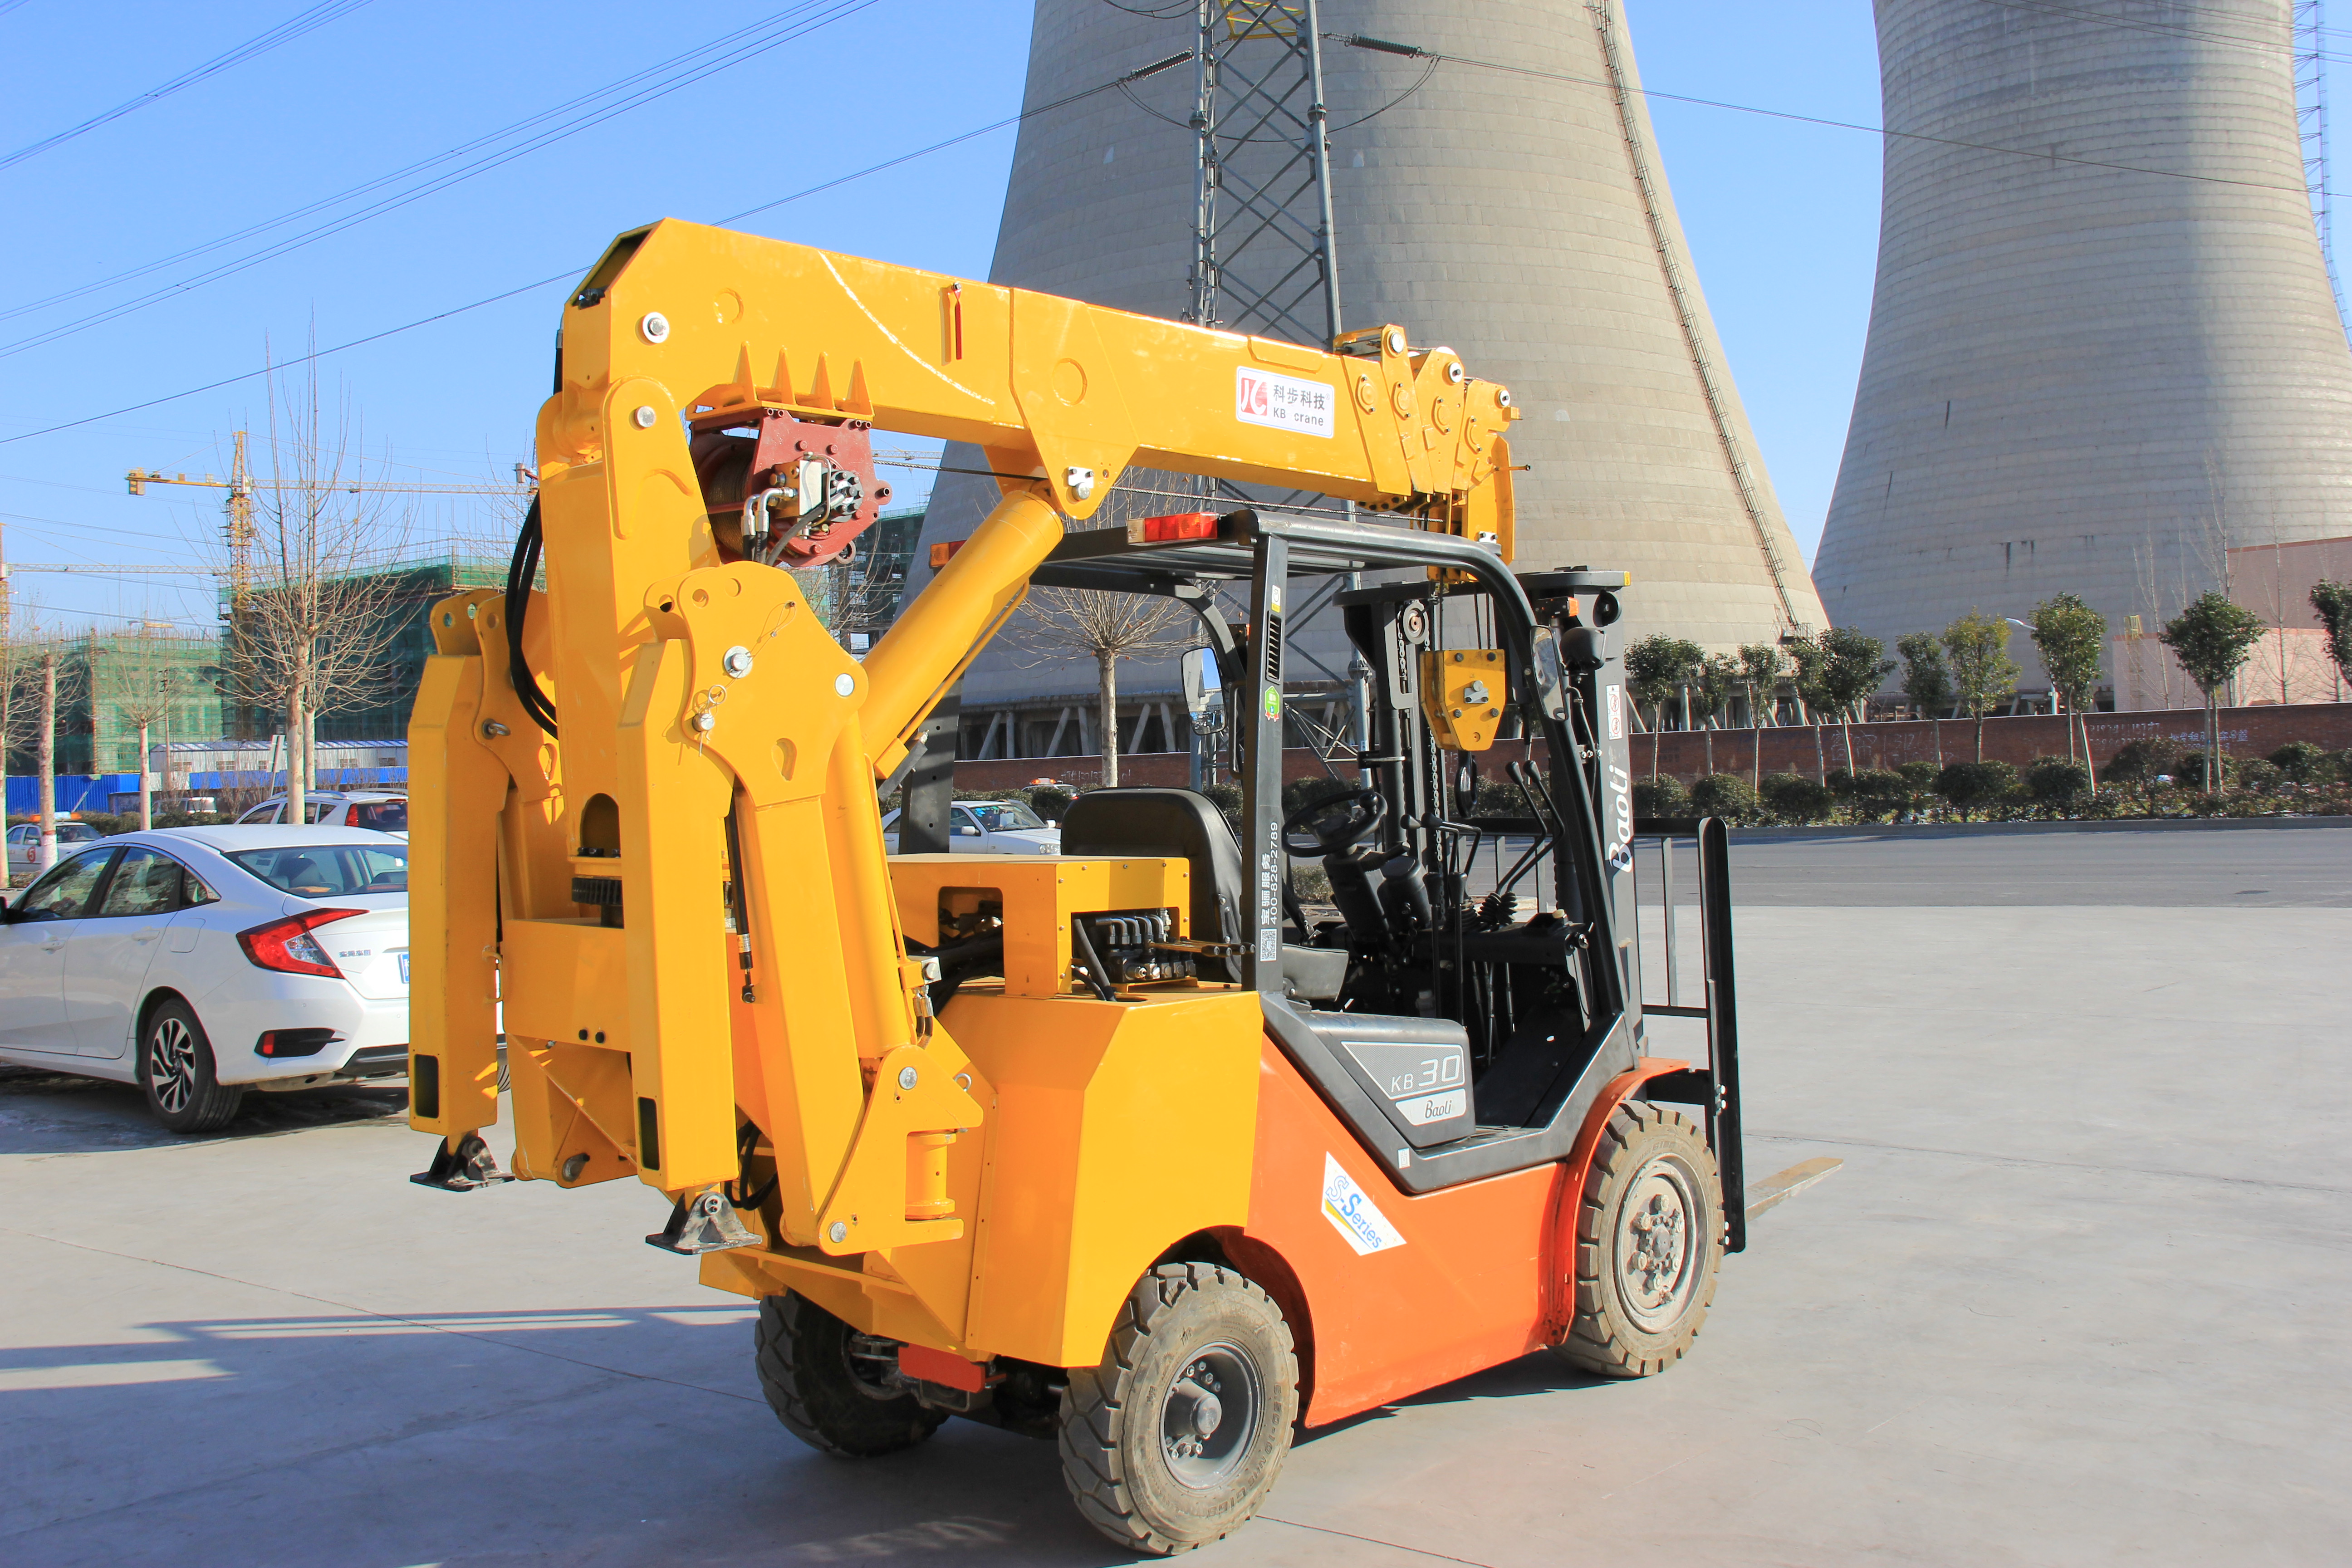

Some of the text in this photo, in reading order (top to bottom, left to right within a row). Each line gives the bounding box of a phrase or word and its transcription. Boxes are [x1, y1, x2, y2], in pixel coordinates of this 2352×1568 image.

[1273, 384, 1325, 411] 科步科技
[1273, 407, 1324, 426] KB crane
[1608, 764, 1633, 873] Baoli
[29, 848, 34, 860] 5
[1261, 853, 1270, 926] 宝骊服务
[1391, 1054, 1460, 1093] KB 30
[1425, 1100, 1452, 1119] Baoli
